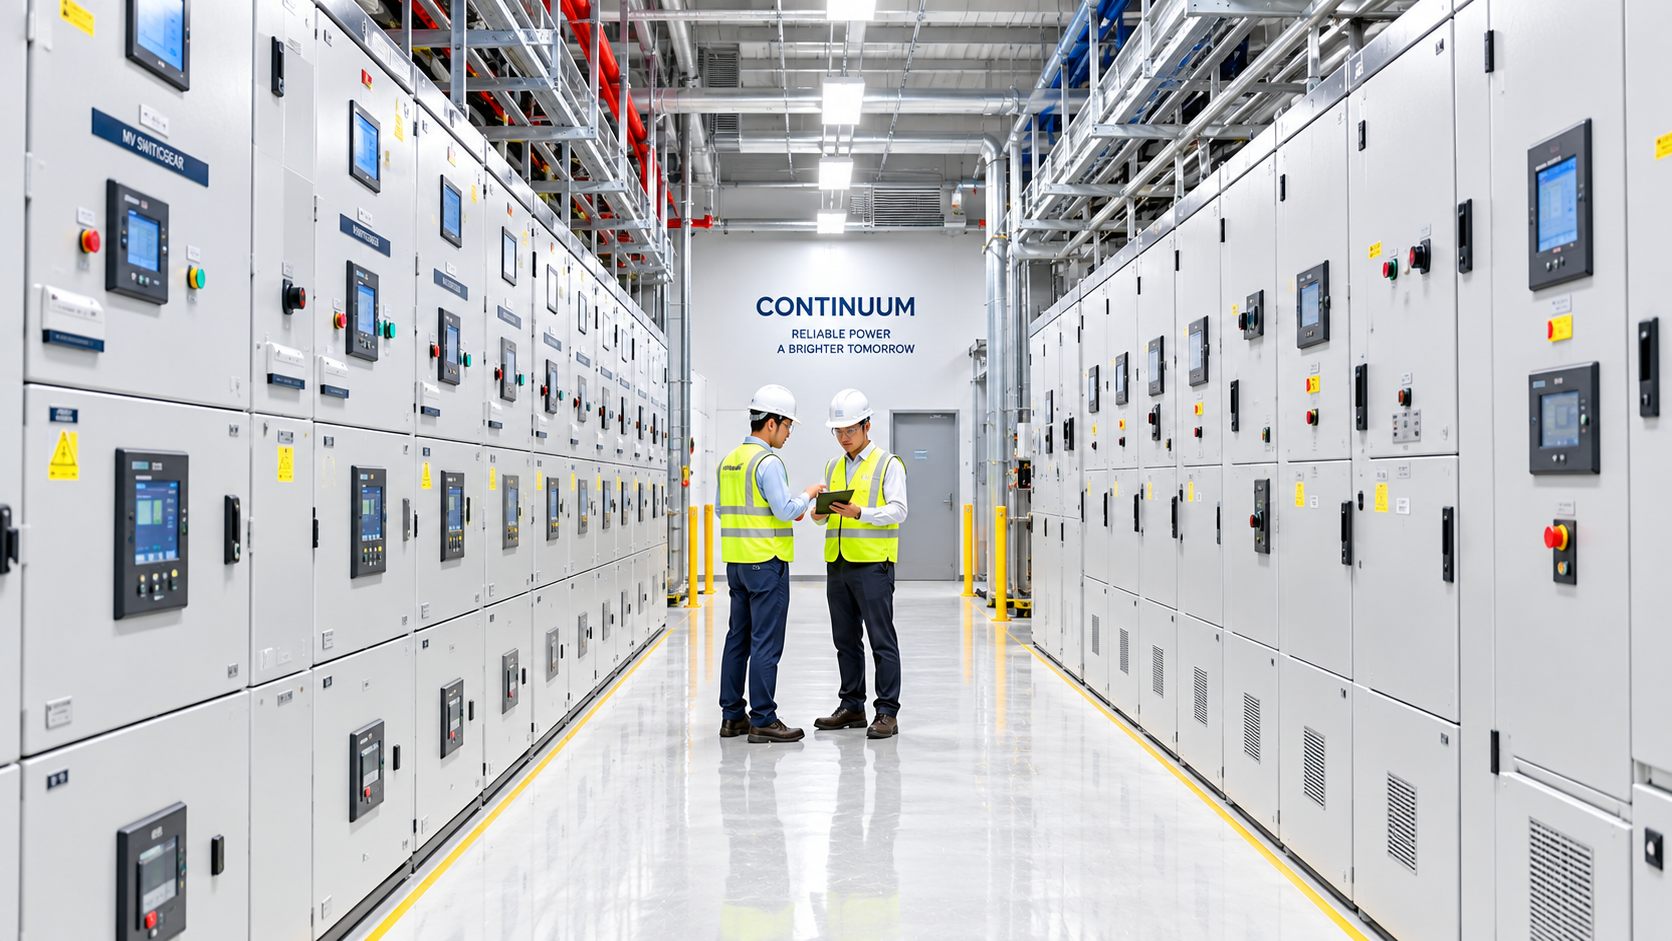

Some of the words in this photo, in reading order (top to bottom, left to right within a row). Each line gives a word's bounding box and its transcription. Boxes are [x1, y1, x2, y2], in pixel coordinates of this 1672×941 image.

[756, 296, 915, 317] CONTINUUM
[791, 328, 846, 339] RELIABLE
[849, 328, 891, 339] POWER
[777, 344, 786, 354] A
[788, 344, 844, 354] BRIGHTER
[847, 344, 916, 354] TOMORROW
